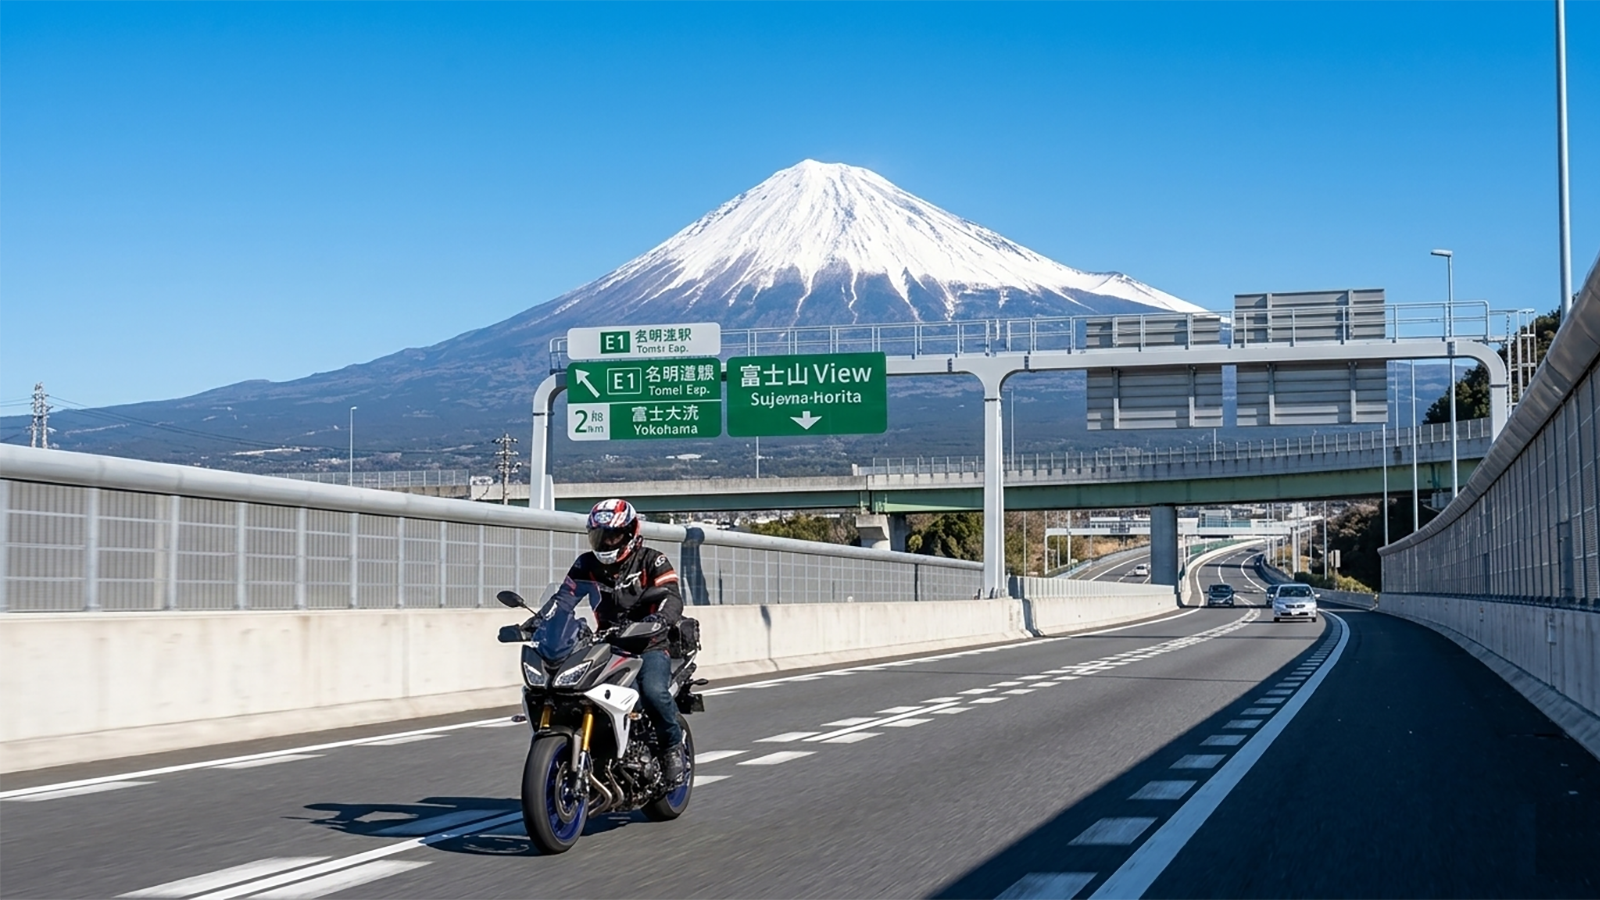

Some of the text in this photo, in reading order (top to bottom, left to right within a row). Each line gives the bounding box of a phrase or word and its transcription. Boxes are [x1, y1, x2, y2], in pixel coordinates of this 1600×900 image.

[605, 335, 624, 350] E1
[613, 373, 634, 390] E1
[740, 362, 872, 387] 富士山 View
[575, 410, 588, 433] 2
[633, 424, 698, 436] Yokohama
